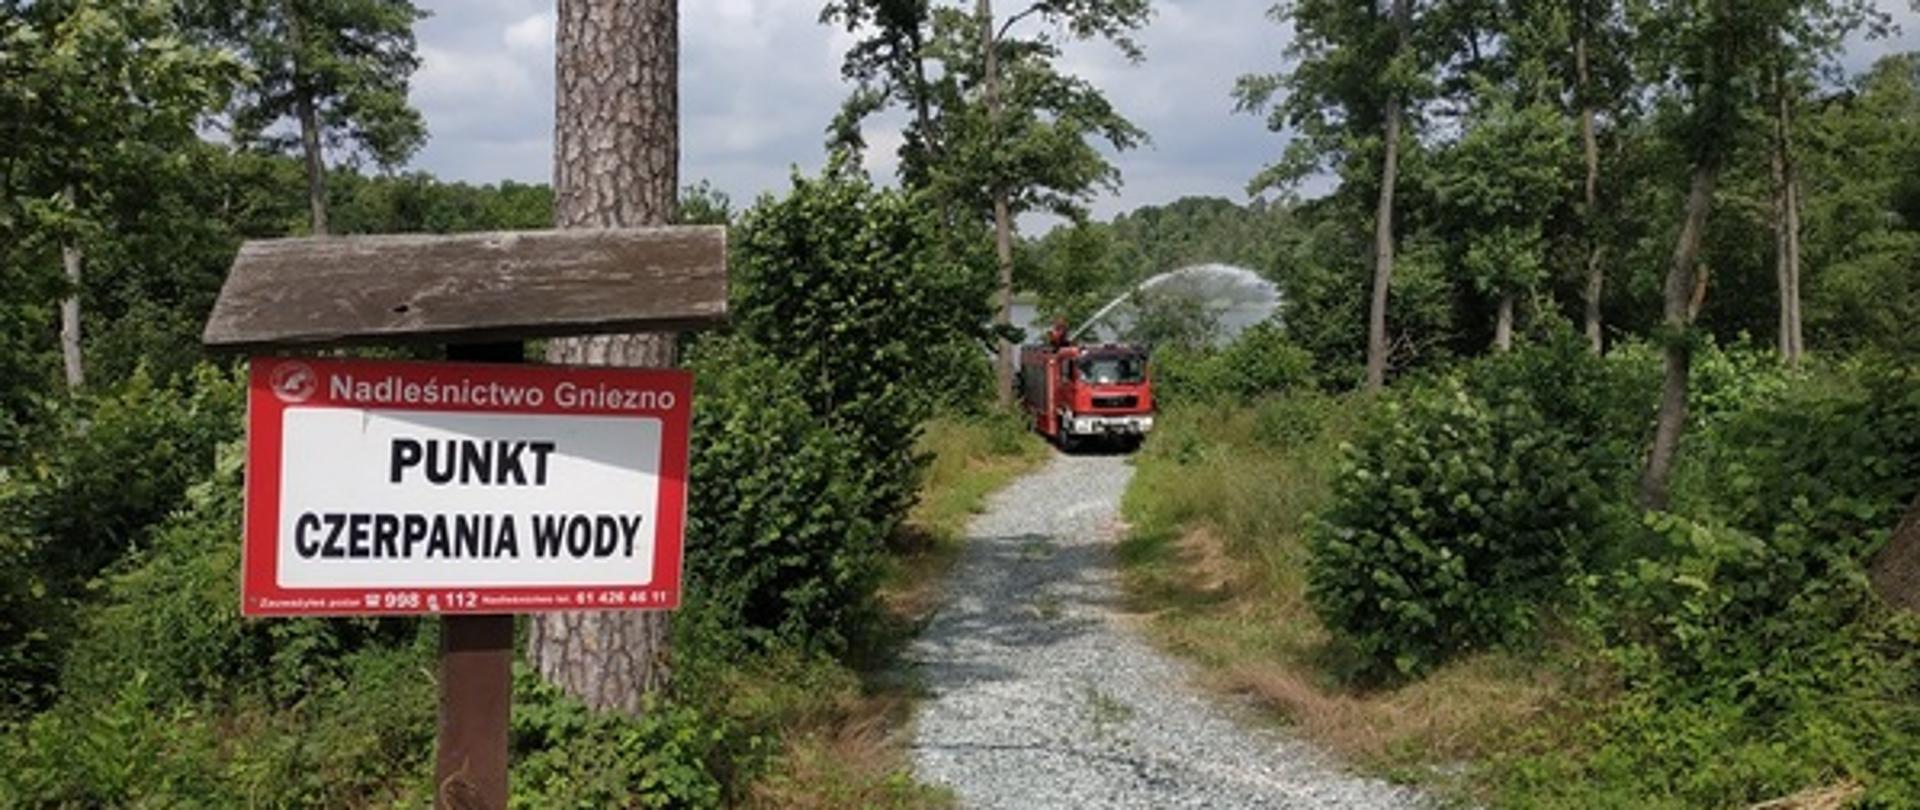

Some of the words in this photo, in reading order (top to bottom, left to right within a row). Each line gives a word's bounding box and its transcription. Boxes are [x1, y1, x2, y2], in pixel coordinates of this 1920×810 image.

[329, 374, 543, 407] Nadleśnictwo
[554, 382, 676, 411] Gniezno
[390, 438, 555, 486] PUNKT
[295, 512, 519, 560] CZERPANIA
[533, 514, 643, 558] WODY
[384, 592, 419, 607] 998
[445, 592, 477, 607] 112
[576, 591, 594, 605] 61
[598, 591, 625, 604] 426
[652, 591, 666, 603] 11
